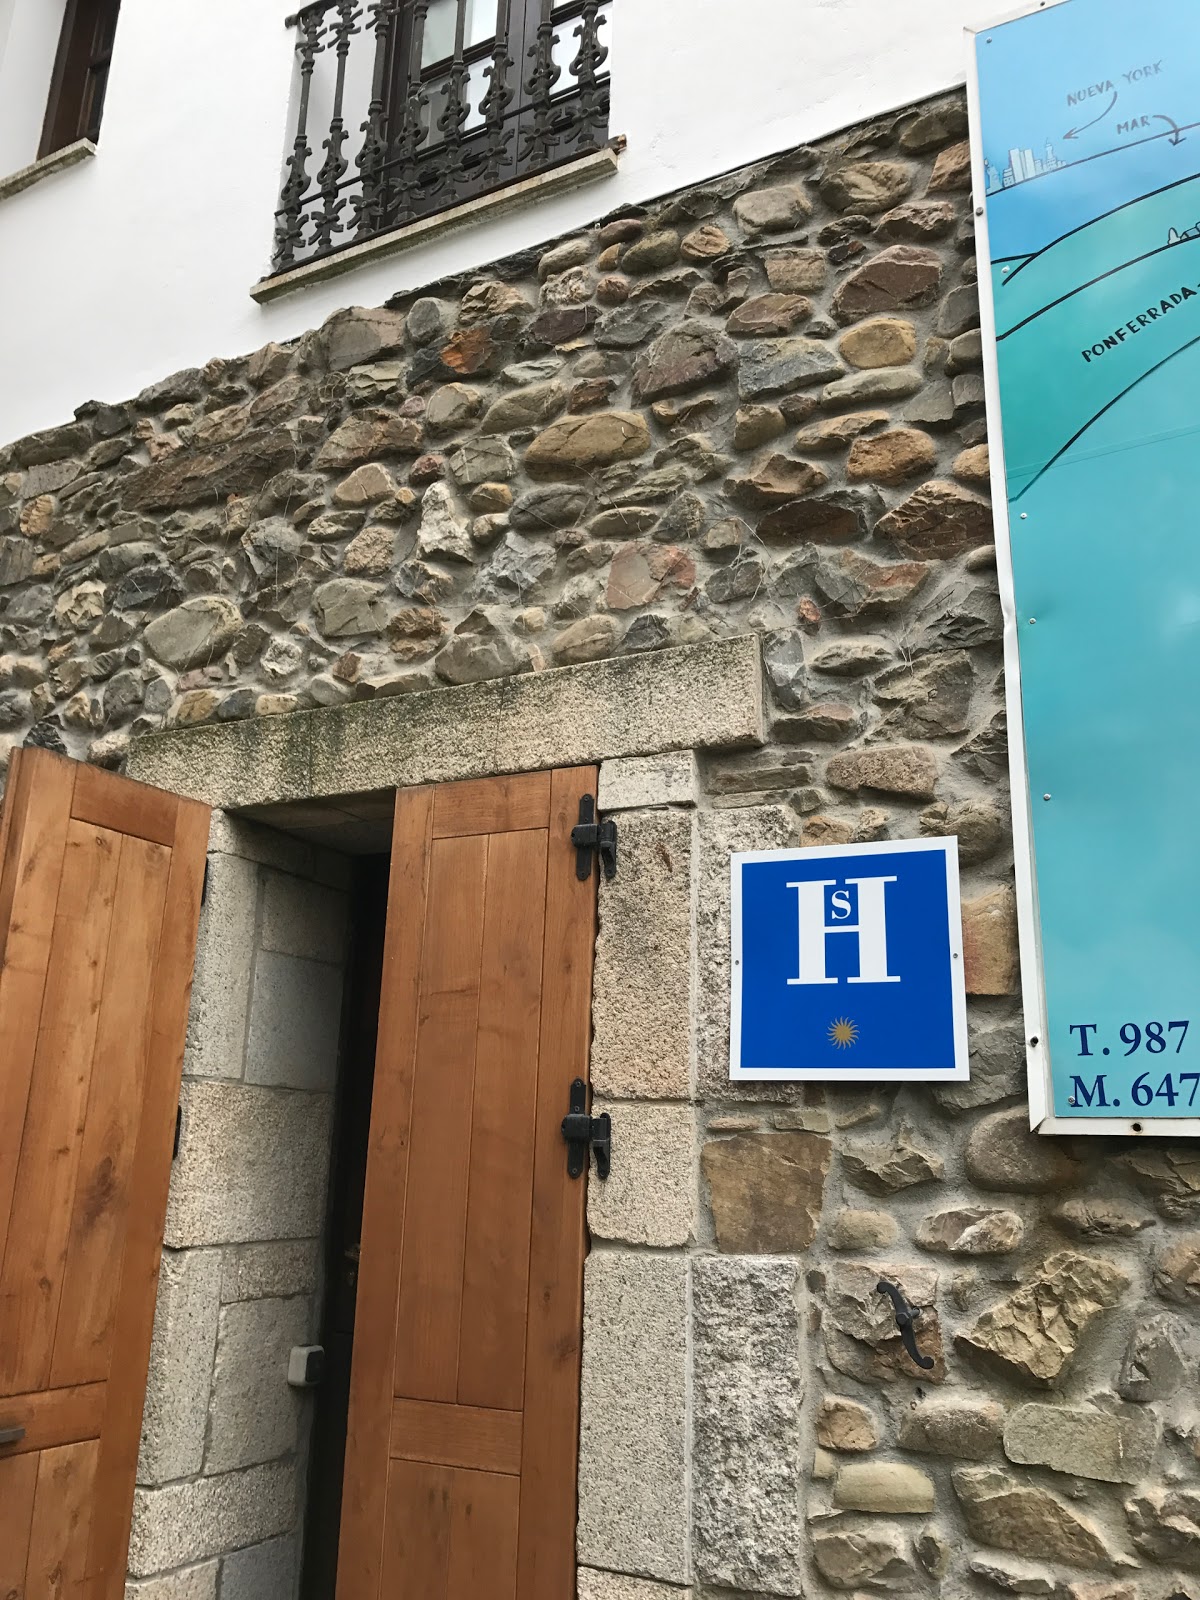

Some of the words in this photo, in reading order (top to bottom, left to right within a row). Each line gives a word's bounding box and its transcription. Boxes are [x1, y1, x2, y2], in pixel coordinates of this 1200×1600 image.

[1066, 79, 1115, 107] NUEVA
[1121, 59, 1164, 84] YORK
[1116, 115, 1151, 135] MAR
[1081, 286, 1198, 363] PONFERRADA
[1119, 1020, 1190, 1057] 987
[1131, 1071, 1200, 1107] 647
